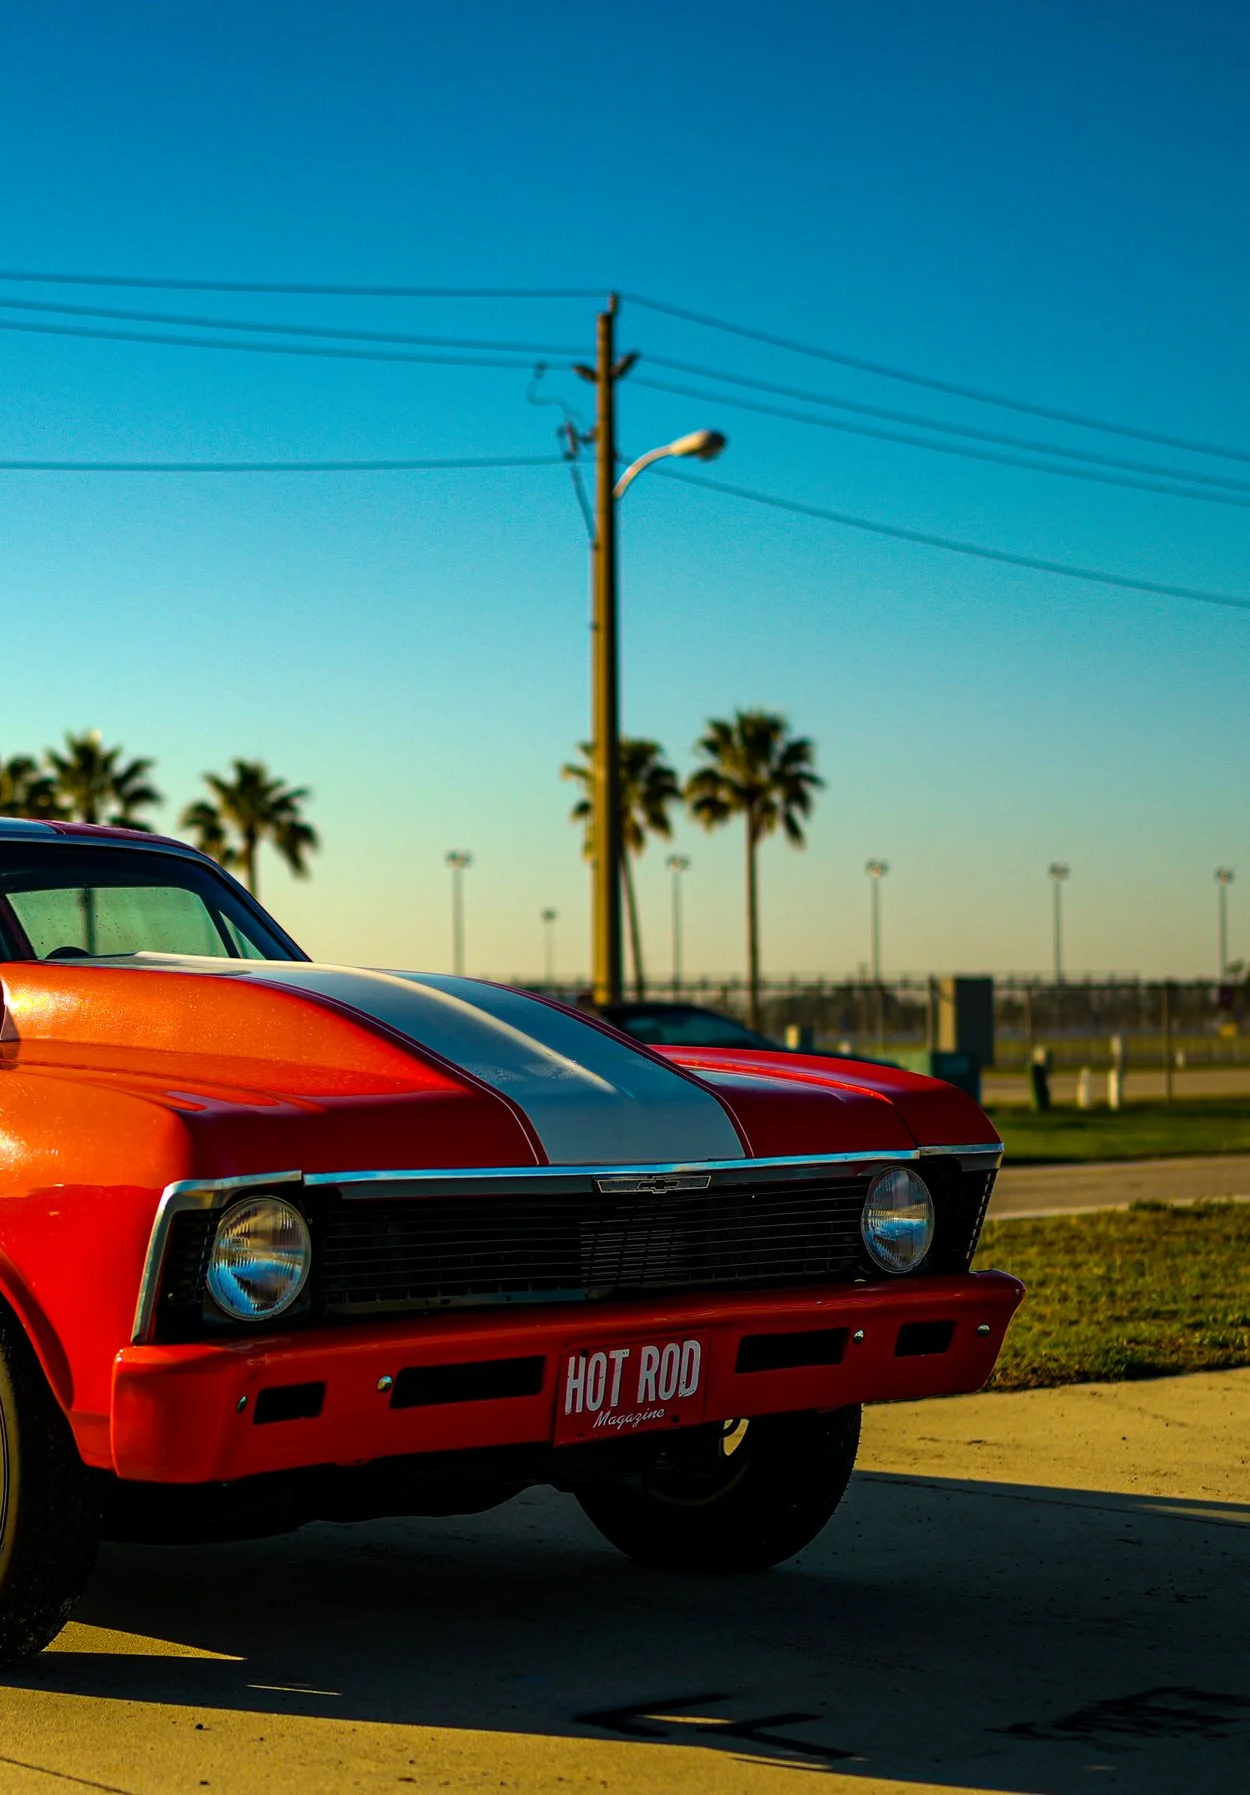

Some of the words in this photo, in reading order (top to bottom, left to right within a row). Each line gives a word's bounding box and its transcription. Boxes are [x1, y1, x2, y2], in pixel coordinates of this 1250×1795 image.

[565, 1349, 630, 1415] HOT
[637, 1340, 701, 1404] ROD
[593, 1407, 665, 1430] Magazine
